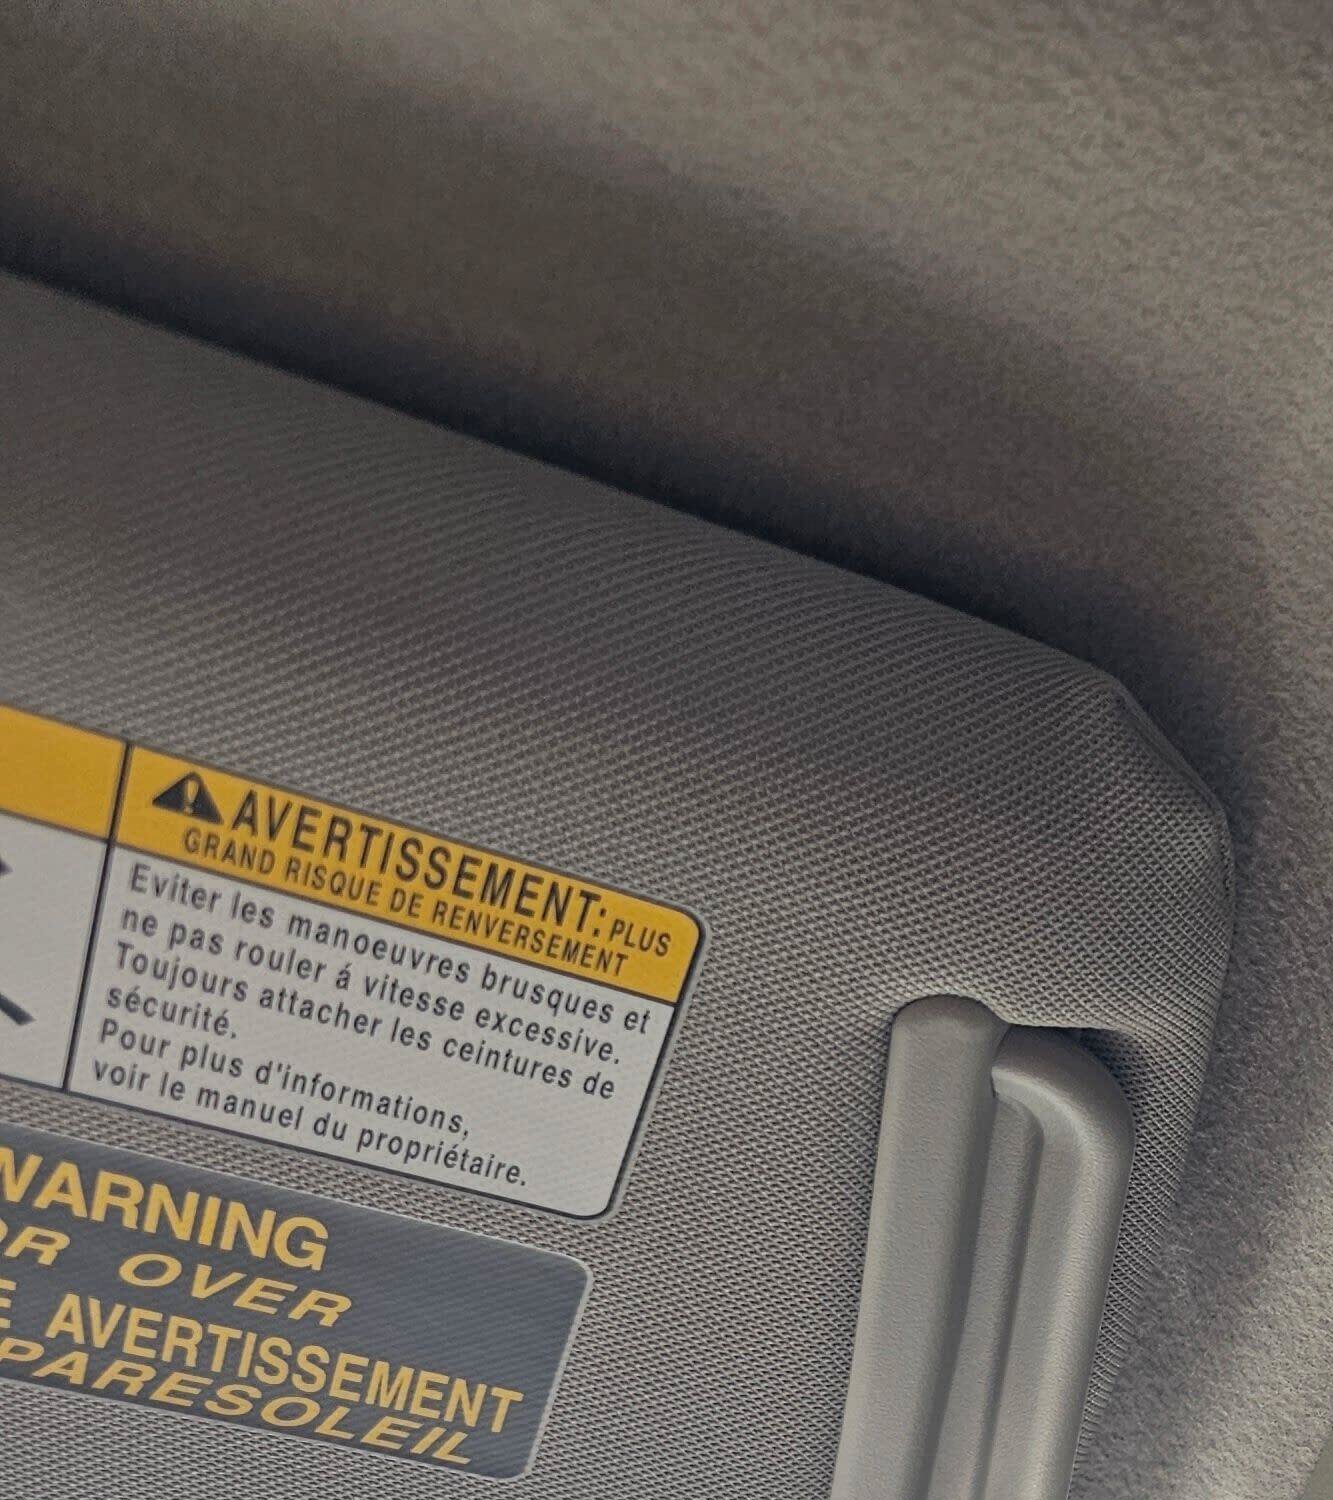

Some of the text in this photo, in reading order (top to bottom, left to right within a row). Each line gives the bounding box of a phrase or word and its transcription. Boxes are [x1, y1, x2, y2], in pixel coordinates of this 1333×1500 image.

[183, 827, 629, 977] GRAND RISQUE DE RENVERSEMENT
[231, 790, 673, 957] AVERTISSEMENT: PLUS
[107, 985, 238, 1040] sécurité.
[122, 908, 158, 938] ne
[168, 922, 223, 956] pas
[234, 940, 327, 983] rouler
[365, 973, 465, 1022] vitesse
[474, 1007, 620, 1065] excessive.
[130, 862, 651, 1035] Eviter les manoeuvres brusques et
[100, 1017, 470, 1139] Pour plus d'informations,
[117, 940, 615, 1100] Toujours attacher les ceintures de
[94, 1060, 526, 1187] voir le manuel du propriétaire.
[118, 1252, 353, 1327] OVER
[0, 1337, 473, 1465] PARESOLEIL
[45, 1293, 524, 1433] AVERTISSEMENT
